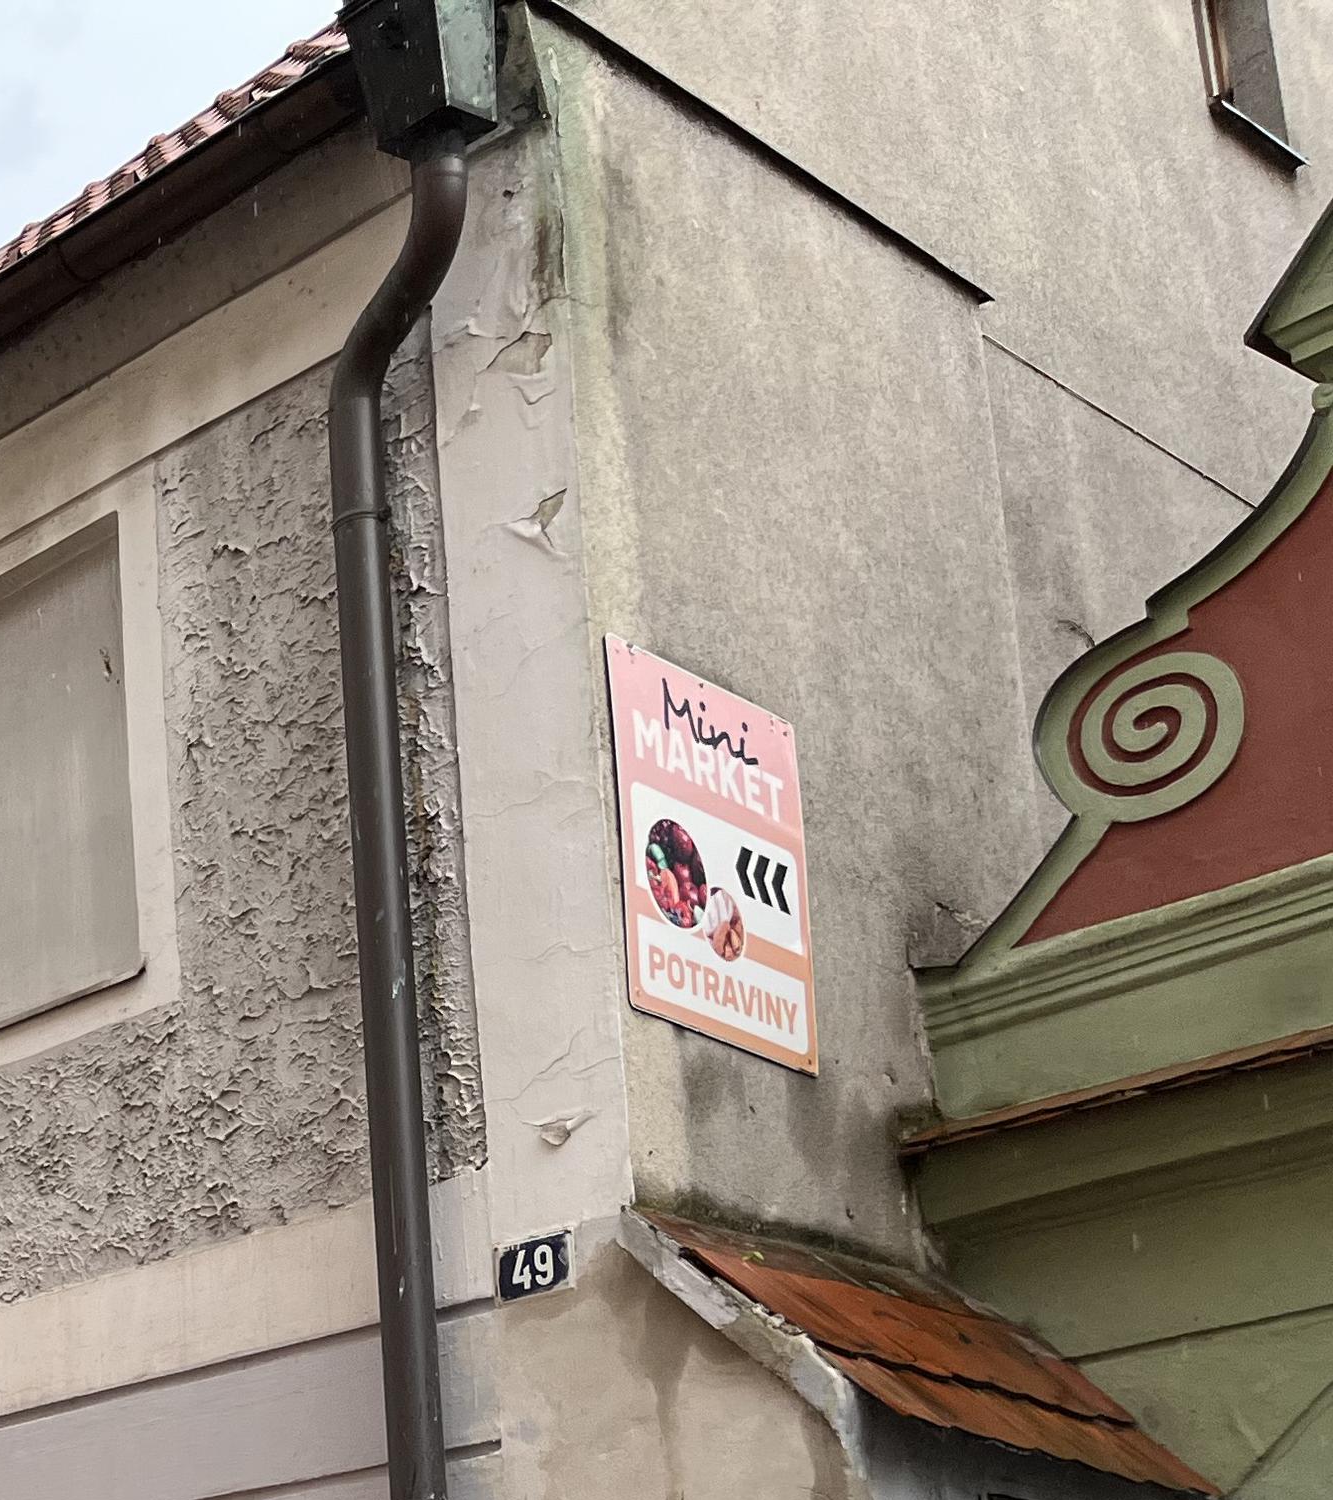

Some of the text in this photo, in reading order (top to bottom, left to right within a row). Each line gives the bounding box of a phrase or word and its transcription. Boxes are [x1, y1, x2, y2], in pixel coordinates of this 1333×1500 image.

[632, 708, 784, 824] MARKET
[661, 676, 760, 766] Mini
[648, 945, 800, 1035] POTRAVINY
[511, 1244, 555, 1291] 49
